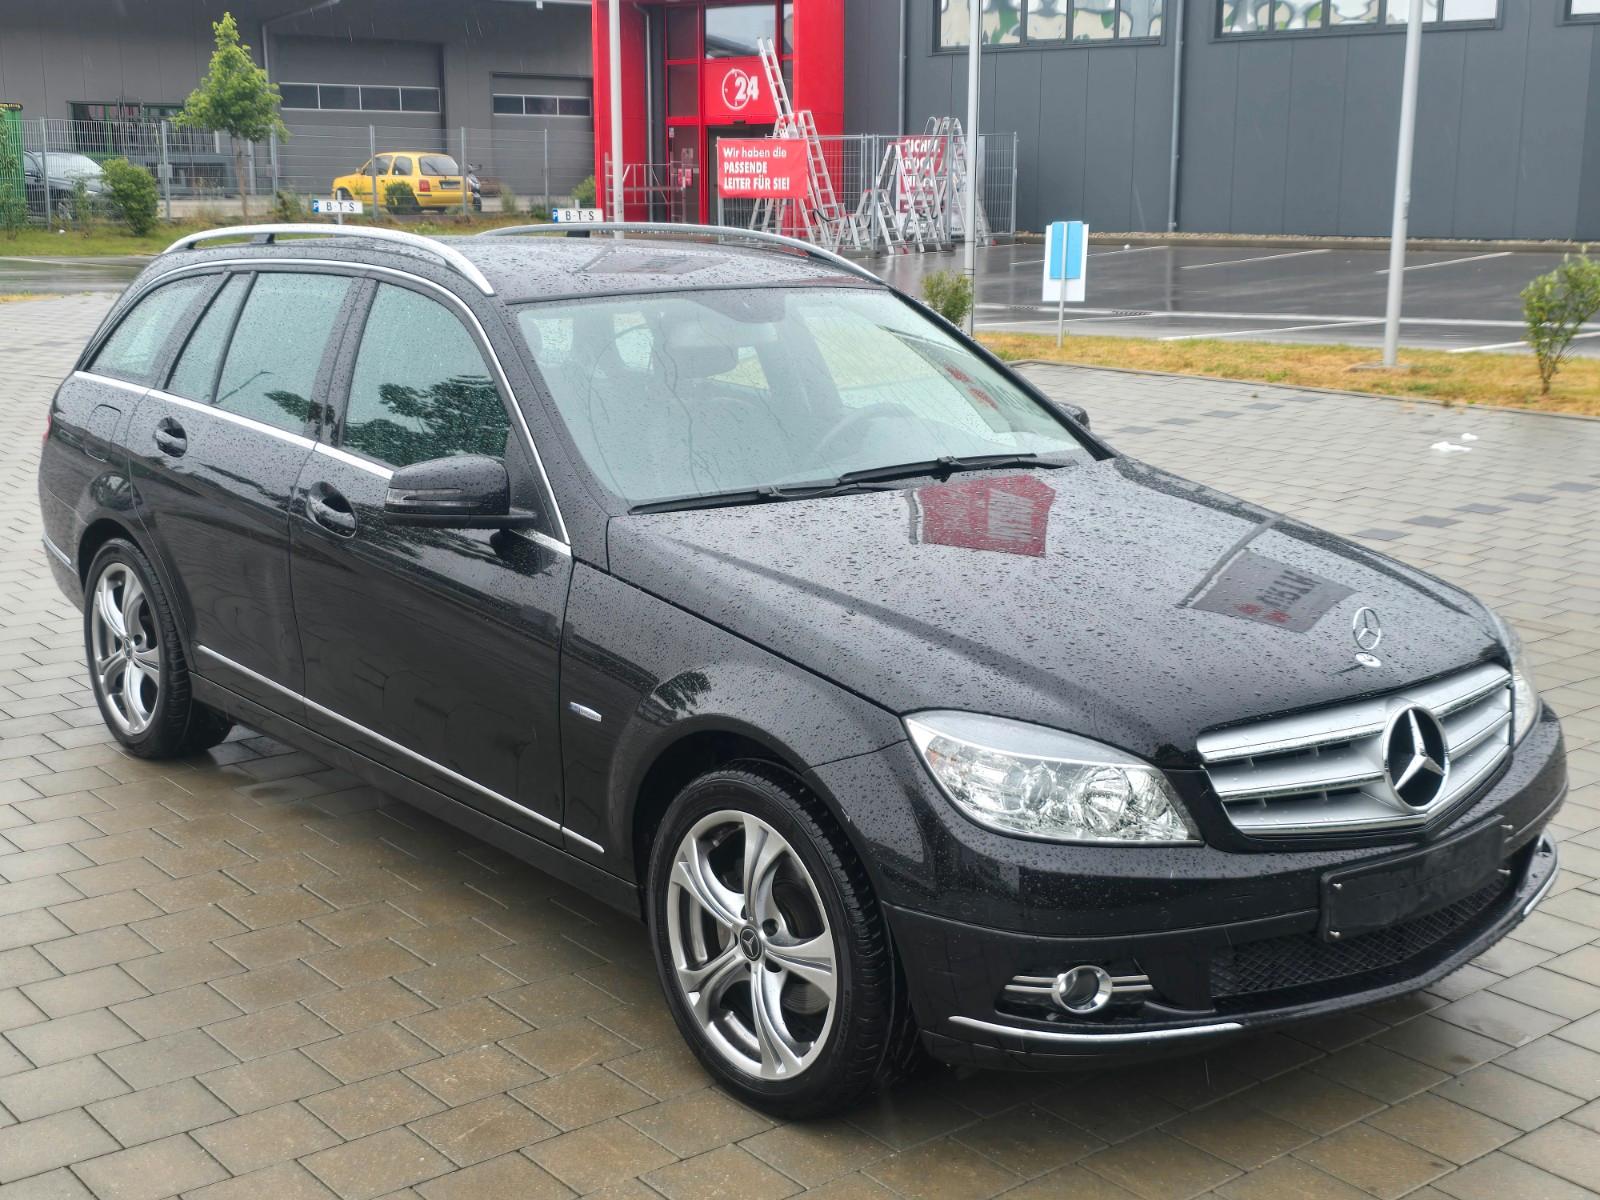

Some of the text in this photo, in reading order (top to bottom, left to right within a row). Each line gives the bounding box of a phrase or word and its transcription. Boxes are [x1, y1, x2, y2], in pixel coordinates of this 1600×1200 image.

[734, 76, 759, 100] 24
[723, 146, 787, 158] Wir haben die
[723, 161, 767, 174] PASSENDE
[723, 174, 790, 191] LEITER FÜR SIE!
